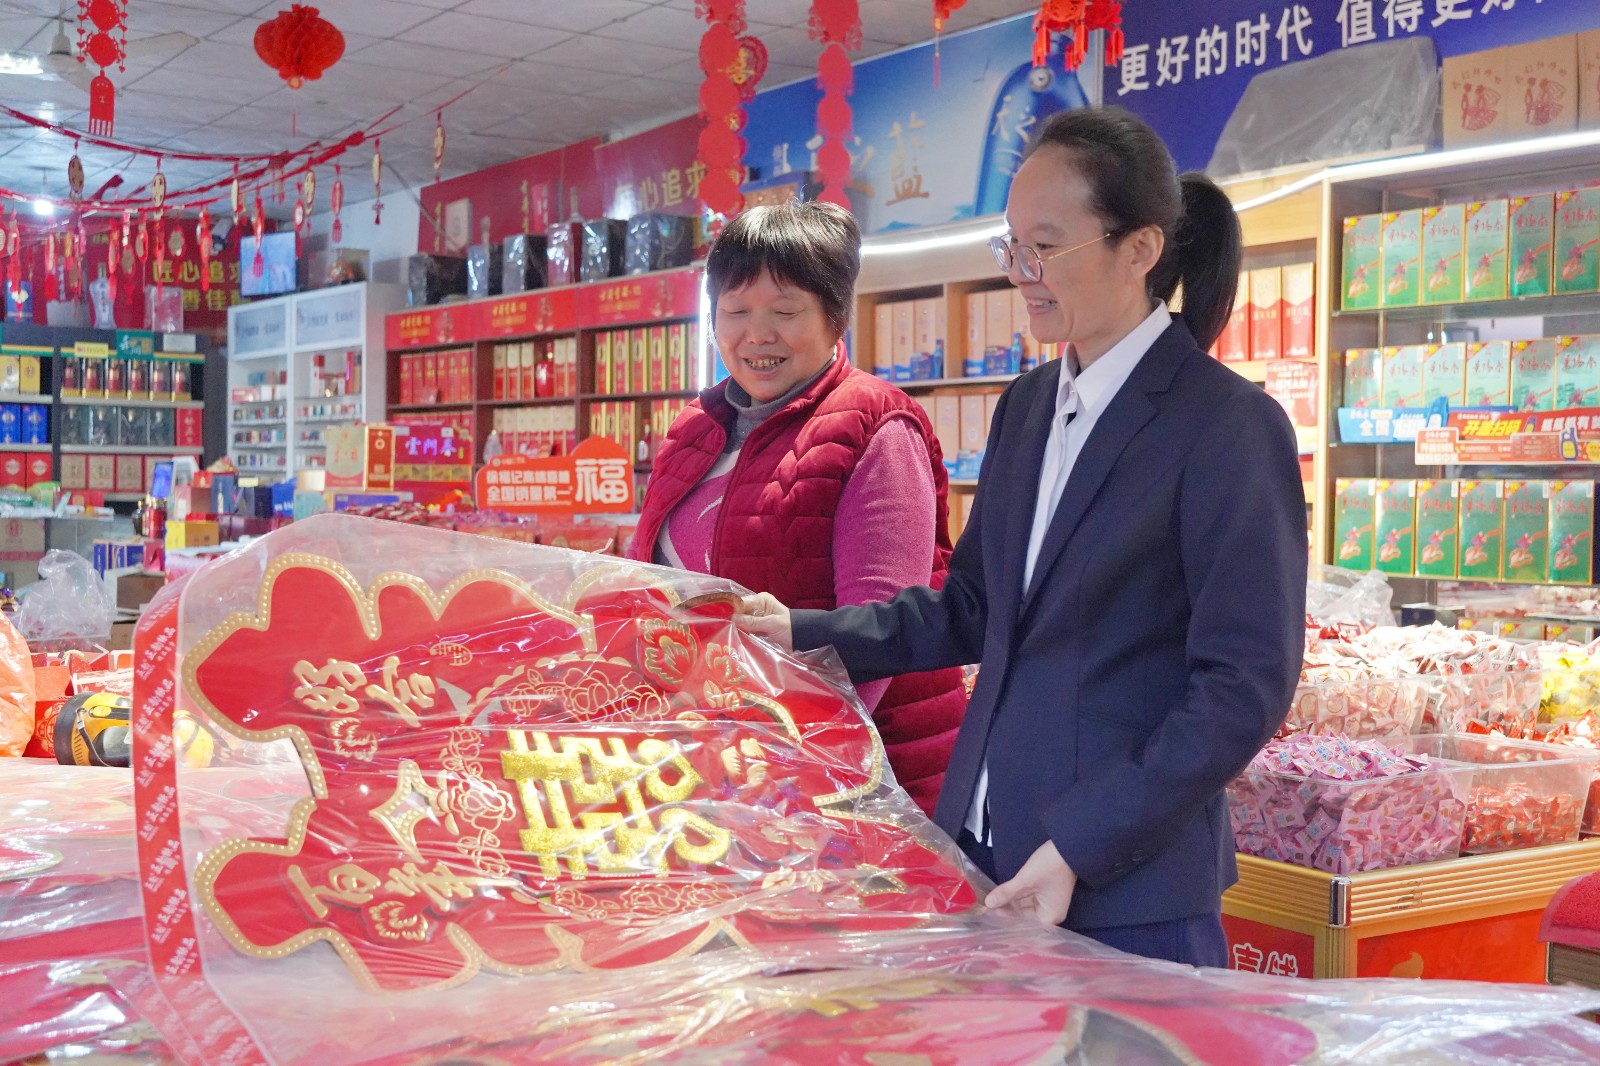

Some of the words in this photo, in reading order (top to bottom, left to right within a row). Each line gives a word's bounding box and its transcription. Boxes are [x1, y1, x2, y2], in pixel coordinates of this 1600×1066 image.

[1117, 5, 1313, 96] 更好的时代
[1336, 0, 1545, 47] 值得更
[1462, 419, 1522, 437] 开盖扫码
[575, 458, 629, 505] 福
[500, 729, 732, 881] 囍
